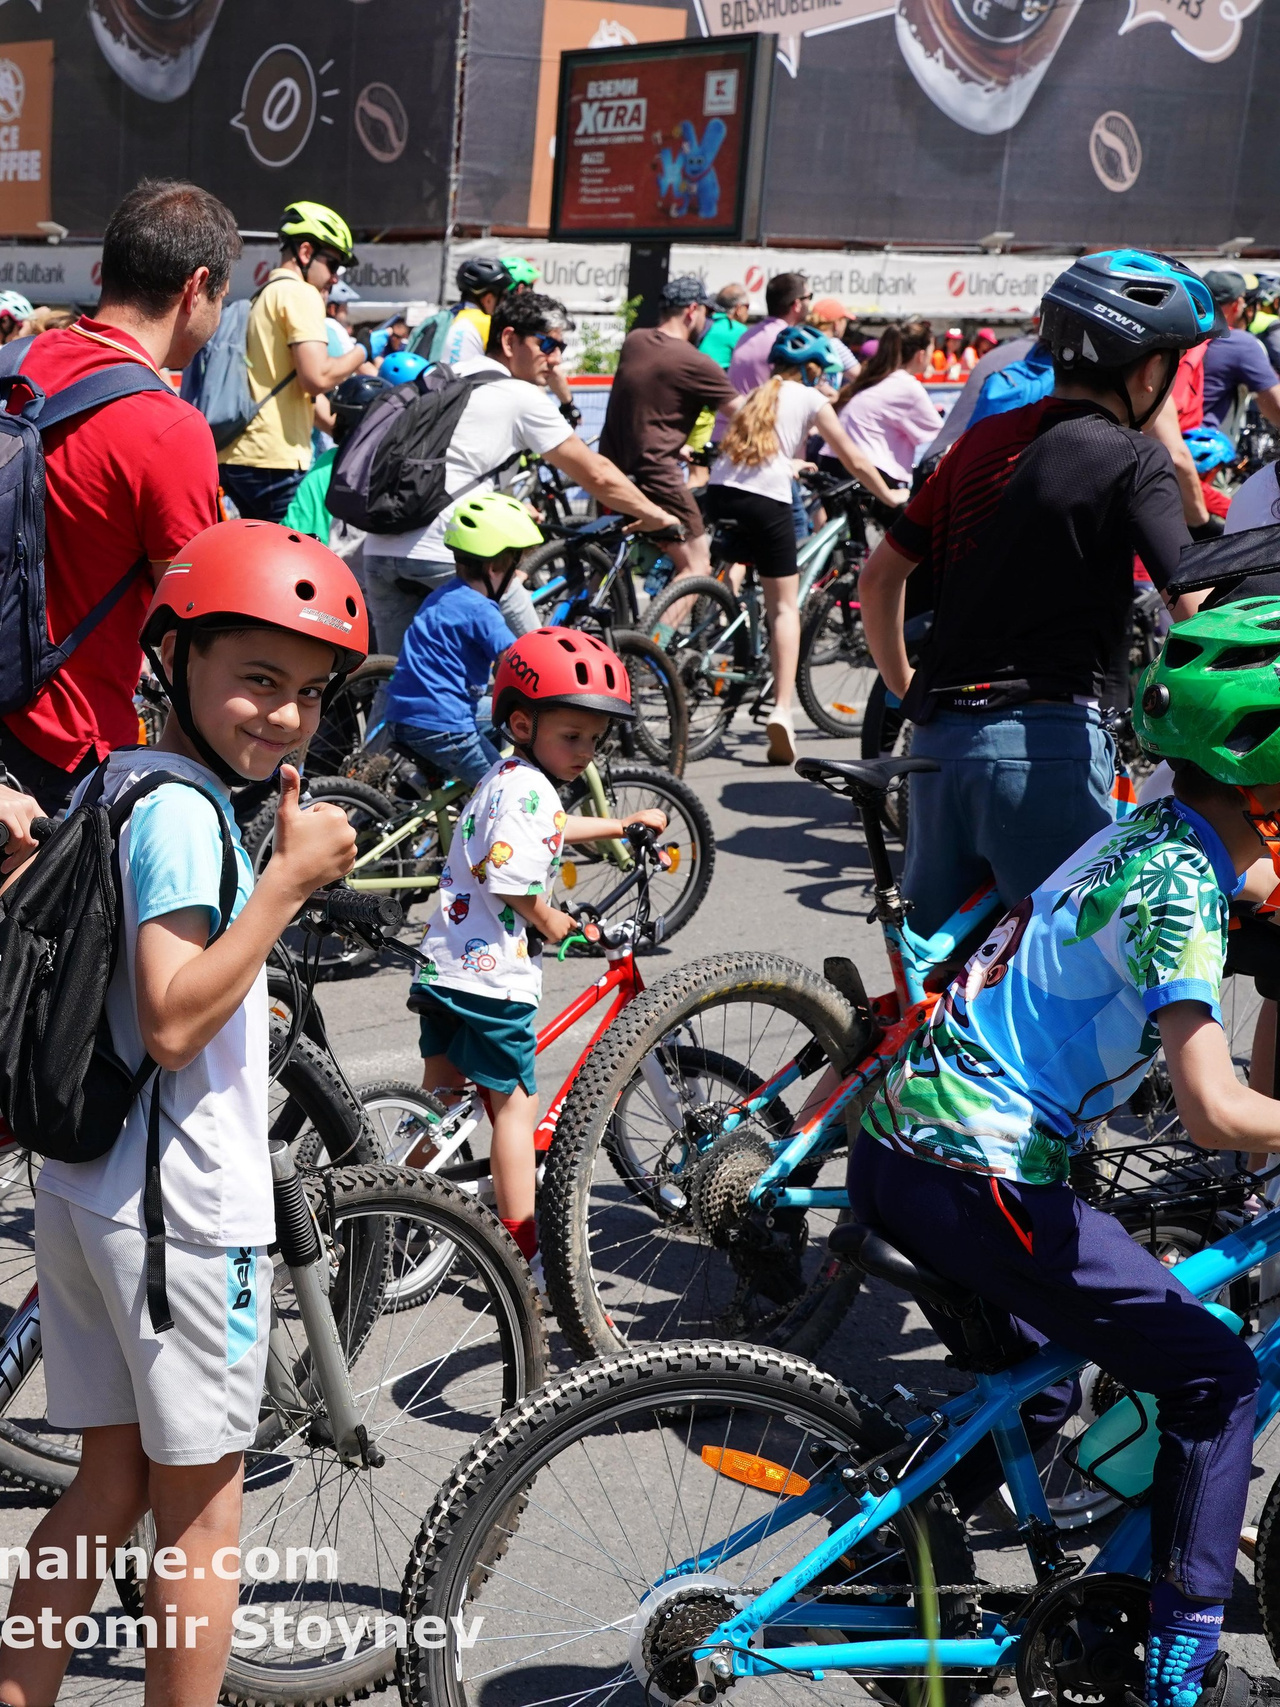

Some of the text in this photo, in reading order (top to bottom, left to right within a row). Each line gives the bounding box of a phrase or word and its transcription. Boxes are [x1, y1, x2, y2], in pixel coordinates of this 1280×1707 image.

[720, 0, 844, 30] ВДЪХНОВЕ
[586, 77, 639, 100] ВЗЕМИ
[16, 261, 66, 284] Bulbank
[849, 269, 917, 296] Bulbank
[968, 271, 1039, 297] UniCredit
[232, 1246, 252, 1310] bek
[1172, 1610, 1224, 1625] COMPRE
